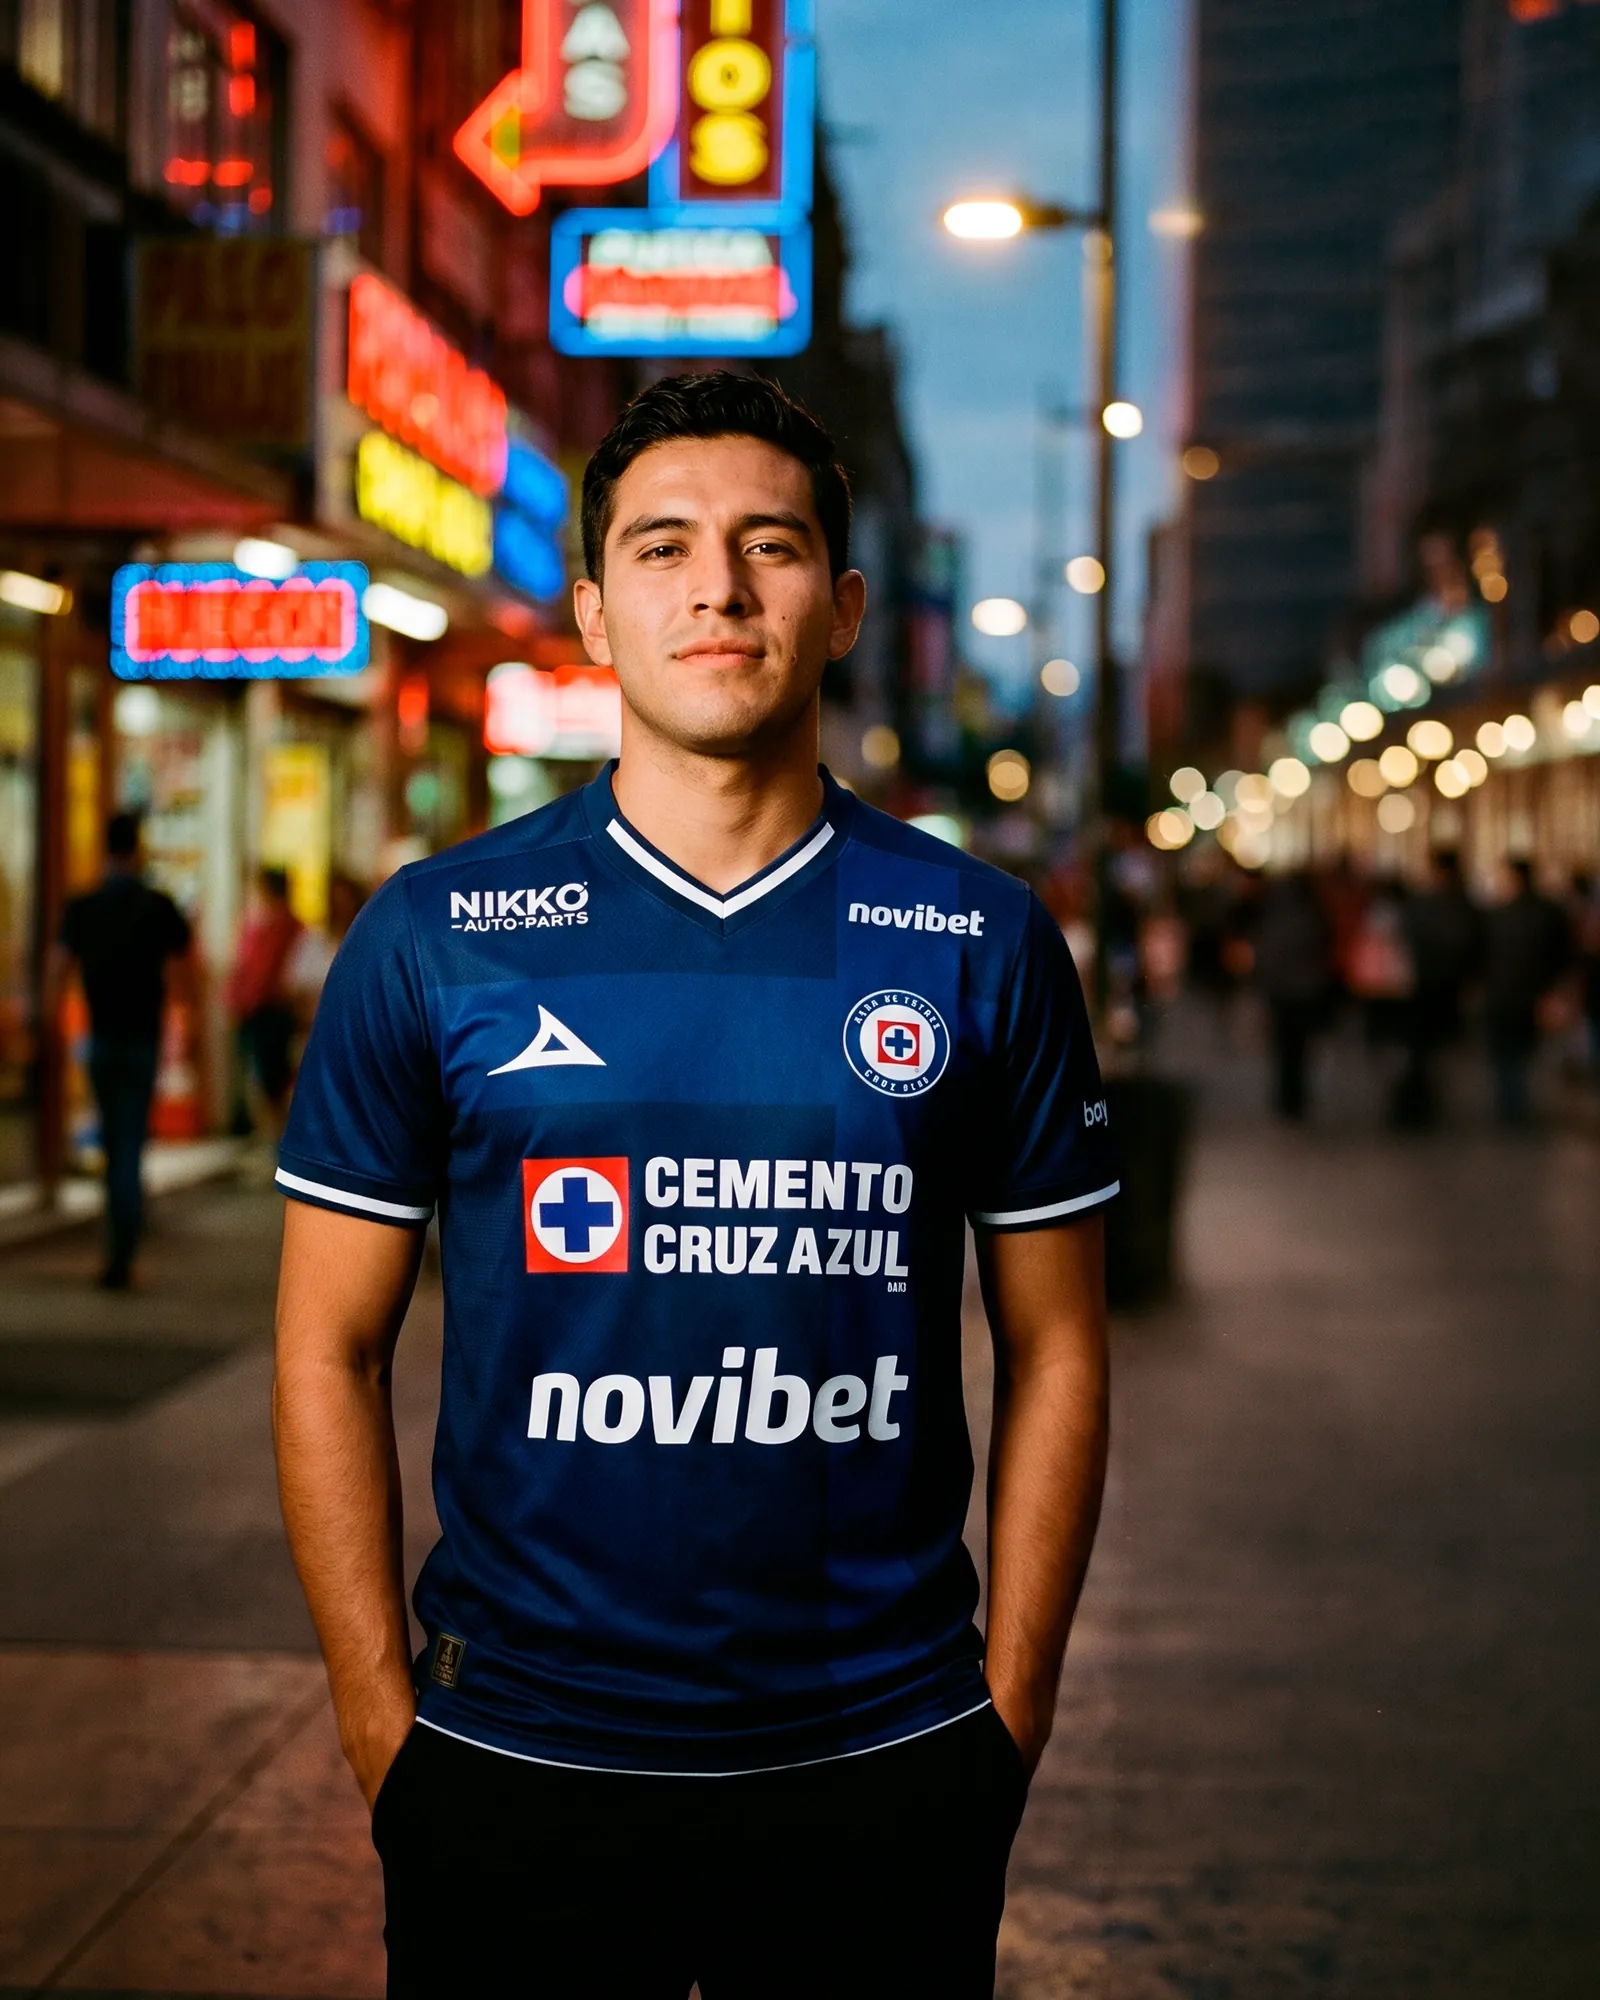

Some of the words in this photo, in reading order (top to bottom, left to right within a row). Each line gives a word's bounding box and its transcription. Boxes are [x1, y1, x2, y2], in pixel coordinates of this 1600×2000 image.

[450, 881, 589, 918] NIKKO
[848, 902, 985, 937] novibet
[644, 1156, 914, 1214] CEMENTO
[643, 1224, 779, 1274] CRUZ
[786, 1227, 909, 1277] AZUL
[527, 1346, 909, 1445] novibet
